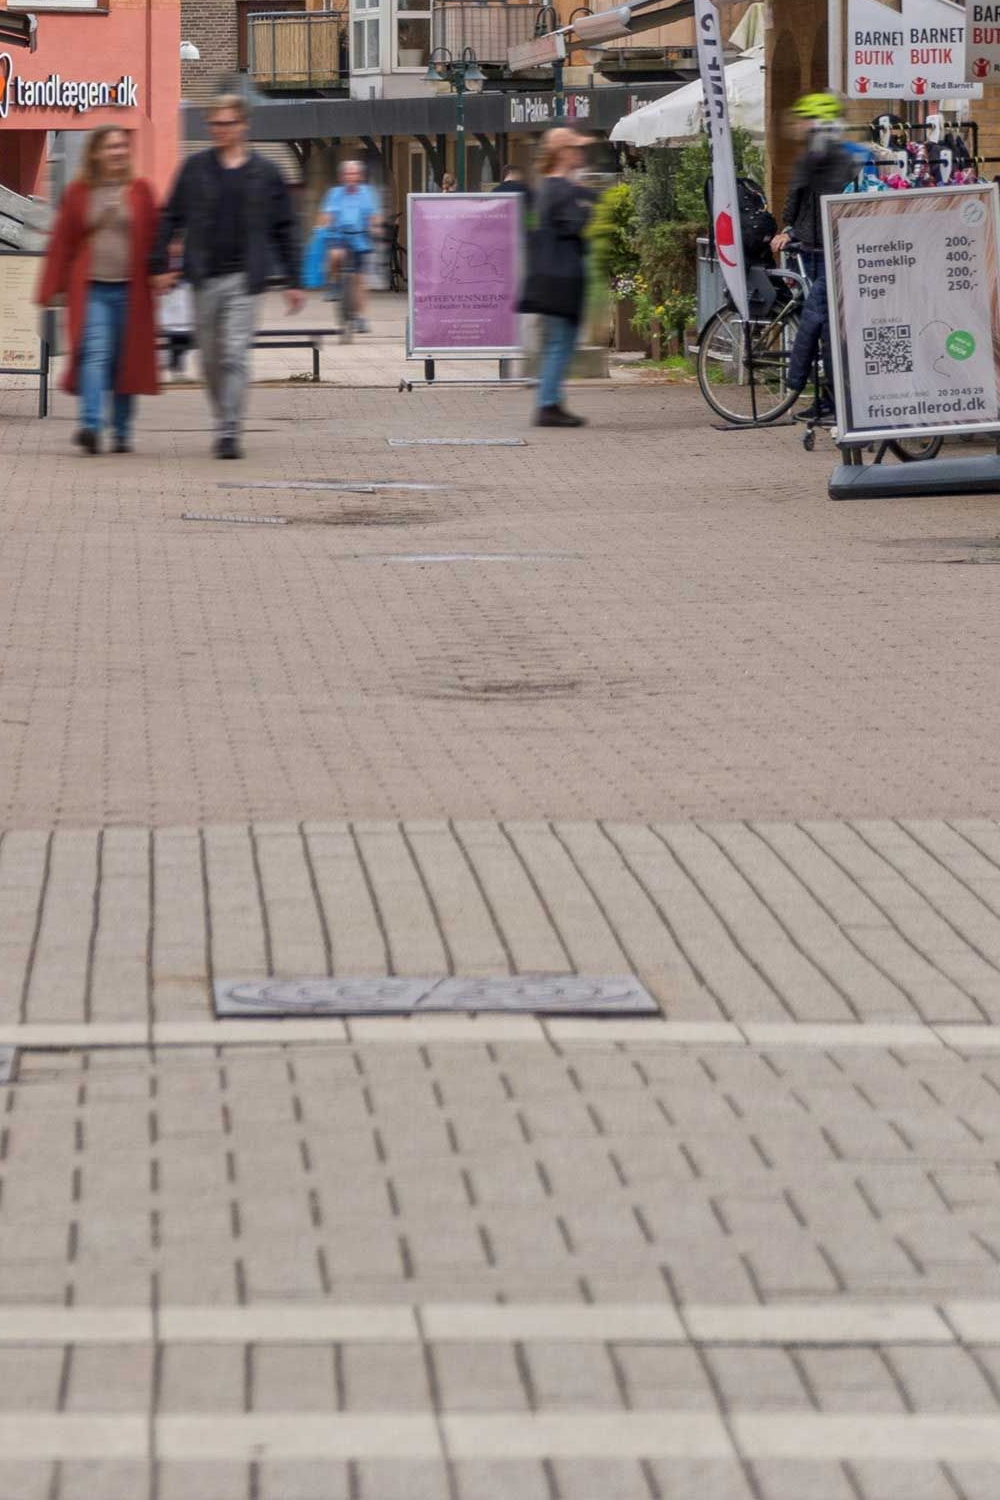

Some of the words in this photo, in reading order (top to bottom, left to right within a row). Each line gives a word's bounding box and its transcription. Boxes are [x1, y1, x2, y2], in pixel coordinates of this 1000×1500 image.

[910, 27, 965, 43] BARNET
[855, 50, 894, 65] BUTIK
[910, 48, 953, 65] BUTIK
[873, 81, 888, 89] Red
[931, 81, 946, 89] Red
[947, 81, 975, 89] Barnet
[510, 97, 523, 122] Din
[856, 240, 913, 254] Herreklip
[945, 236, 976, 247] 200,-
[857, 255, 917, 269] Dameklip
[946, 250, 977, 262] 400,-
[858, 273, 896, 285] Dreng
[947, 266, 978, 278] 200,-
[859, 287, 886, 299] Pige
[948, 280, 979, 292] 250,-
[937, 389, 948, 397] 20
[950, 388, 960, 396] 20
[961, 387, 972, 395] 45
[868, 397, 986, 418] frisorallerod.dk
